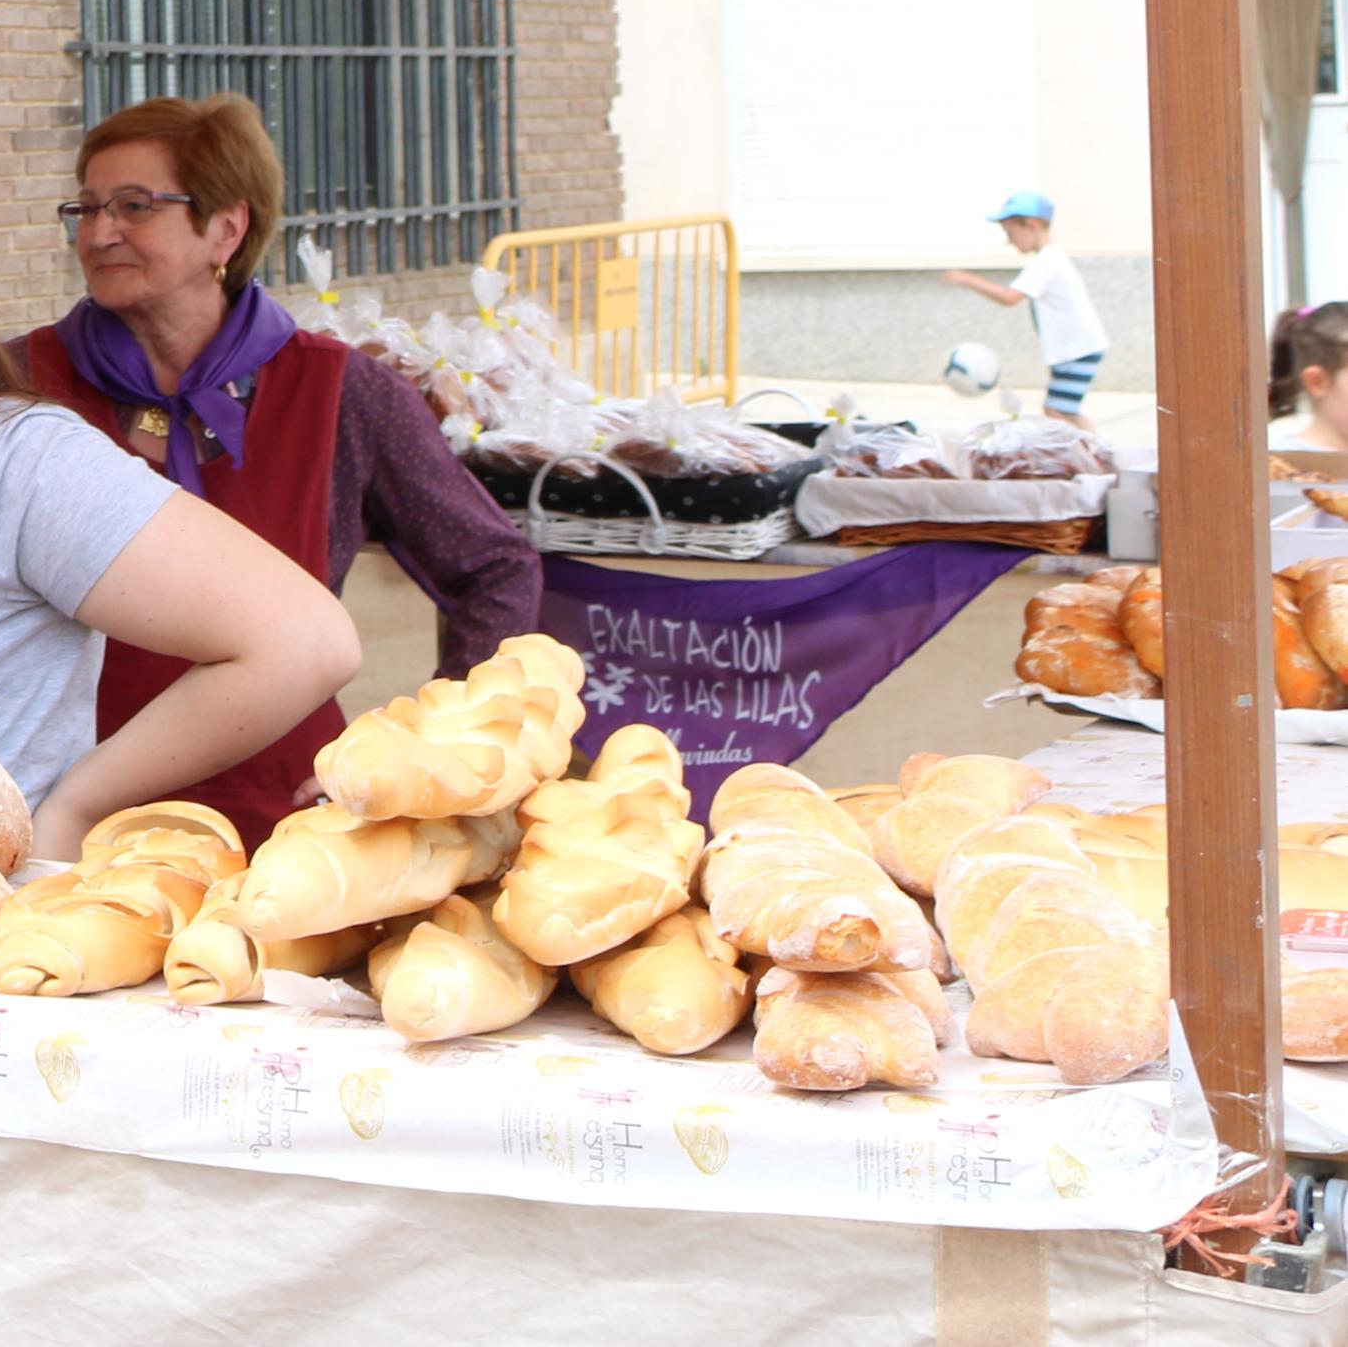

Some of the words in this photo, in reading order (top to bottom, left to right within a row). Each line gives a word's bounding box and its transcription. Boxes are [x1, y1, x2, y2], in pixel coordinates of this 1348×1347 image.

[587, 604, 783, 675] EXALTACIÓN
[642, 674, 674, 715] DE
[684, 678, 725, 720] LAS
[734, 669, 822, 731] LILAS
